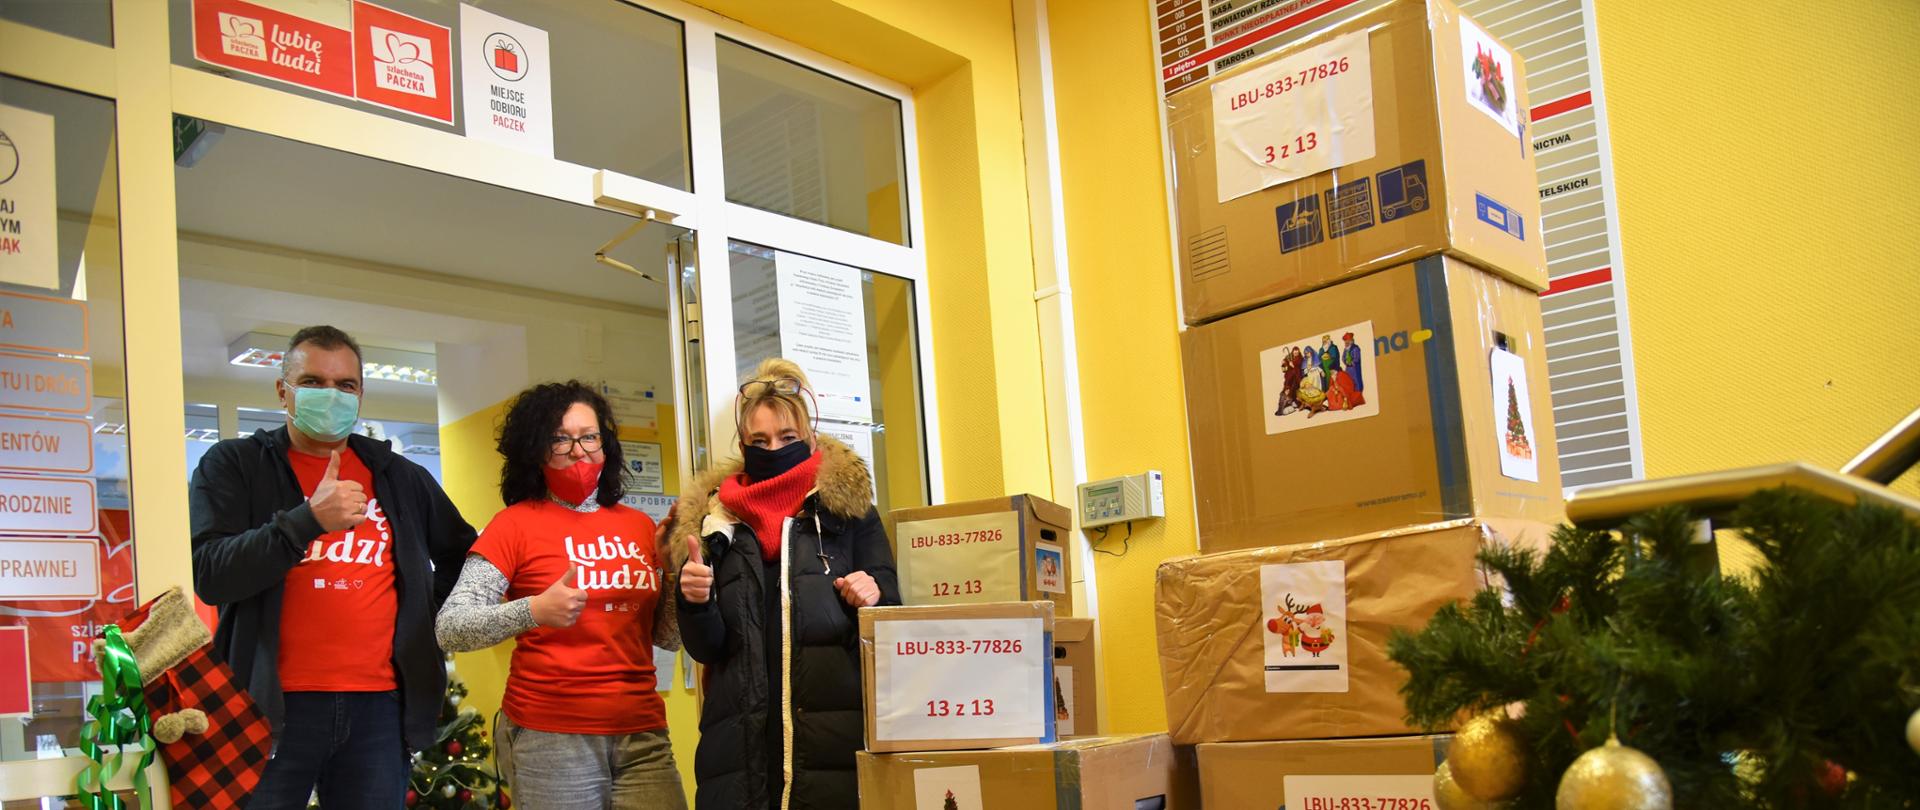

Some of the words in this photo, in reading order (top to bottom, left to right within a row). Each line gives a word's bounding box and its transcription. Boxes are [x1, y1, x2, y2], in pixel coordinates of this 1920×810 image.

[1212, 3, 1232, 16] KASA
[1212, 5, 1258, 29] POWIATOWY
[271, 24, 322, 58] Lubię
[272, 48, 321, 75] ludzi
[1216, 49, 1254, 69] STAROSTA
[386, 64, 425, 82] szlachetna
[386, 73, 425, 93] PACZKA
[490, 84, 525, 104] MIEJSCE
[1231, 57, 1349, 111] LBU-833-77826
[490, 99, 527, 119] ODBIORU
[493, 114, 525, 133] PACZEK
[1265, 146, 1275, 163] 3
[1281, 145, 1289, 159] z
[1296, 132, 1317, 154] 13
[1539, 178, 1588, 198] TELSKICH
[1, 430, 60, 453] ENTÓW
[0, 494, 72, 514] RODZINIE
[640, 496, 675, 506] POBRA
[911, 529, 1002, 548] LBU-833-77826
[300, 531, 389, 567] udzi
[564, 535, 648, 567] Lubię
[1, 559, 77, 578] PRAWNEJ
[577, 564, 657, 591] ludzi
[933, 582, 949, 597] 12
[953, 585, 961, 595] z
[964, 580, 982, 594] 13
[896, 639, 1022, 655] LBU-833-77826
[927, 700, 950, 717] 13
[956, 703, 965, 716] z
[971, 699, 994, 716] 13
[1304, 797, 1430, 810] LBU-833-77826
